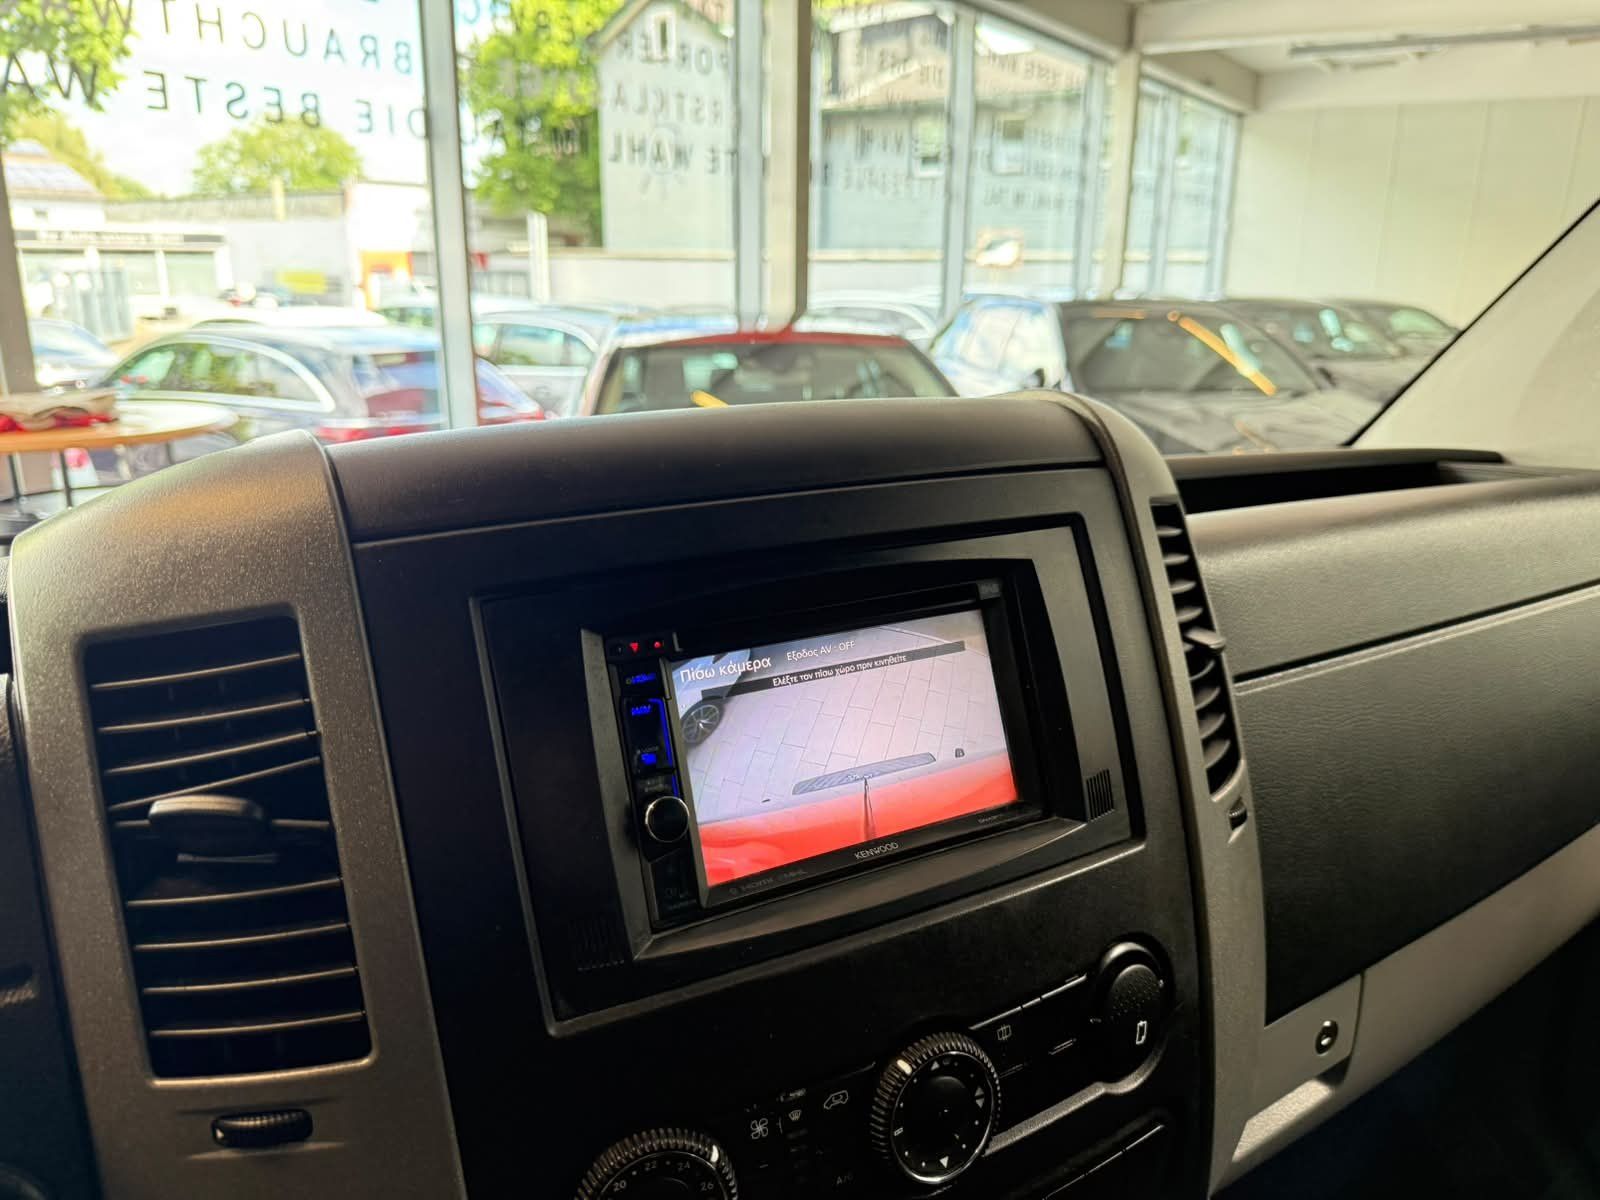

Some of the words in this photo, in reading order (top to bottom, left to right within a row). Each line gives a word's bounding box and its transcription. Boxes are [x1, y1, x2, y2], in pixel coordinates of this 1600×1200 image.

[839, 640, 856, 651] OFF
[680, 667, 716, 683] Πίσω
[719, 657, 772, 676] κάμερα
[853, 842, 899, 860] KENWOOD
[613, 1180, 627, 1191] 20
